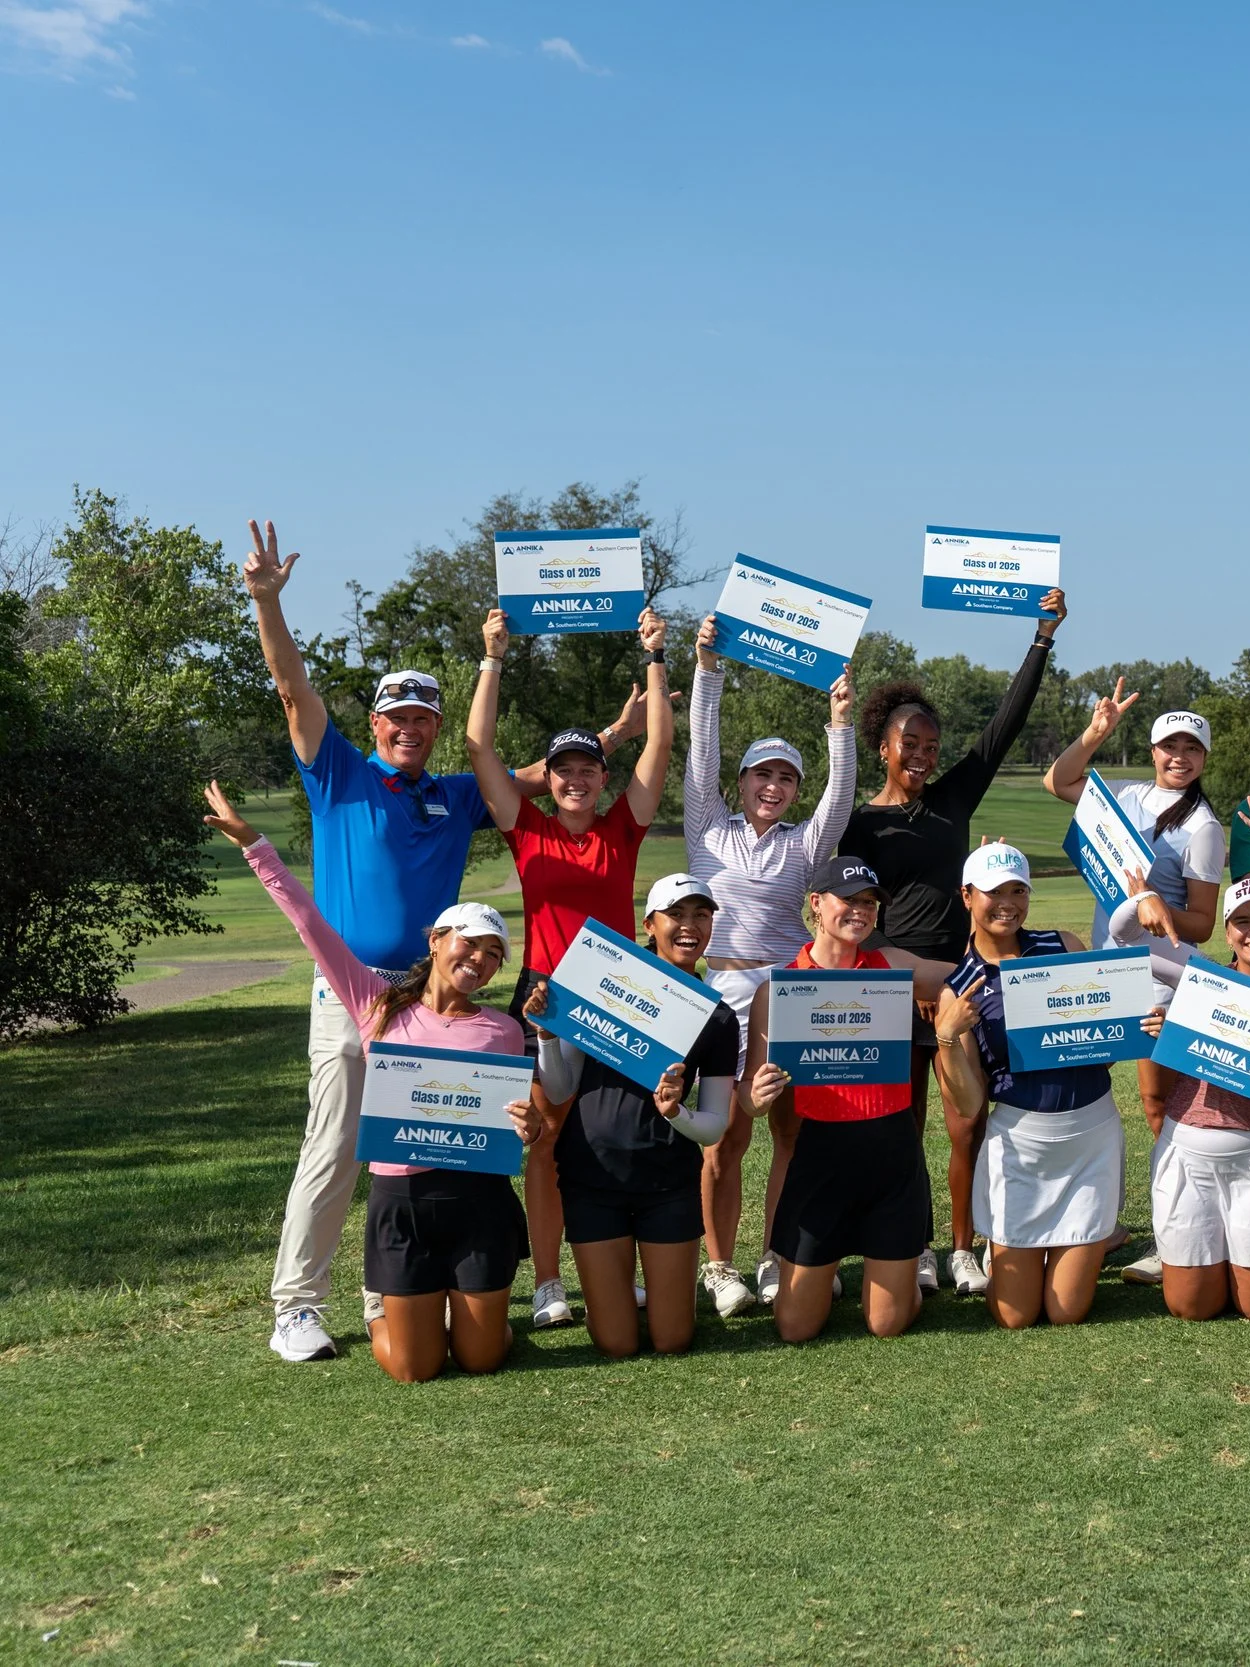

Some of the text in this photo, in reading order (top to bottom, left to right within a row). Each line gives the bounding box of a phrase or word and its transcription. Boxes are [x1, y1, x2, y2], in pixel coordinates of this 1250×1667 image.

[539, 567, 601, 579] Class of 2026
[963, 558, 1020, 571] Class of 2026
[750, 574, 776, 586] ANNIKA
[952, 583, 1028, 598] ANNIKA 20
[531, 597, 613, 613] ANNIKA 20
[760, 602, 820, 630] Class of 2026
[738, 629, 797, 658] ANNIKA
[799, 649, 817, 664] 20
[754, 656, 775, 667] Southern
[774, 663, 796, 675] Company
[1166, 715, 1203, 729] ping
[550, 732, 599, 751] Titleist
[987, 854, 1021, 870] pure
[842, 866, 878, 884] ping
[596, 943, 622, 961] ANNIKA
[1022, 972, 1050, 980] ANNIKA
[1202, 977, 1228, 991] ANNIKA
[599, 977, 660, 1019] Class of 2026
[669, 988, 709, 1015] Southern Company
[1047, 991, 1111, 1008] Class of 2026
[811, 1012, 871, 1024] Class of 2026
[1211, 1008, 1237, 1026] Class
[1237, 1019, 1248, 1031] of
[569, 1005, 628, 1047] ANNIKA
[629, 1038, 650, 1056] 20
[1041, 1024, 1124, 1046] ANNIKA 20
[580, 1037, 602, 1053] Southern
[601, 1049, 622, 1065] Company
[799, 1047, 879, 1062] ANNIKA 20
[1188, 1039, 1247, 1071] ANNIKA
[391, 1060, 422, 1069] ANNIKA
[505, 1075, 529, 1083] Company
[1203, 1069, 1224, 1081] Southern
[1224, 1077, 1245, 1090] Company
[411, 1090, 482, 1108] Class of 2026
[394, 1126, 487, 1148] ANNIKA 20
[442, 1157, 467, 1166] Company
